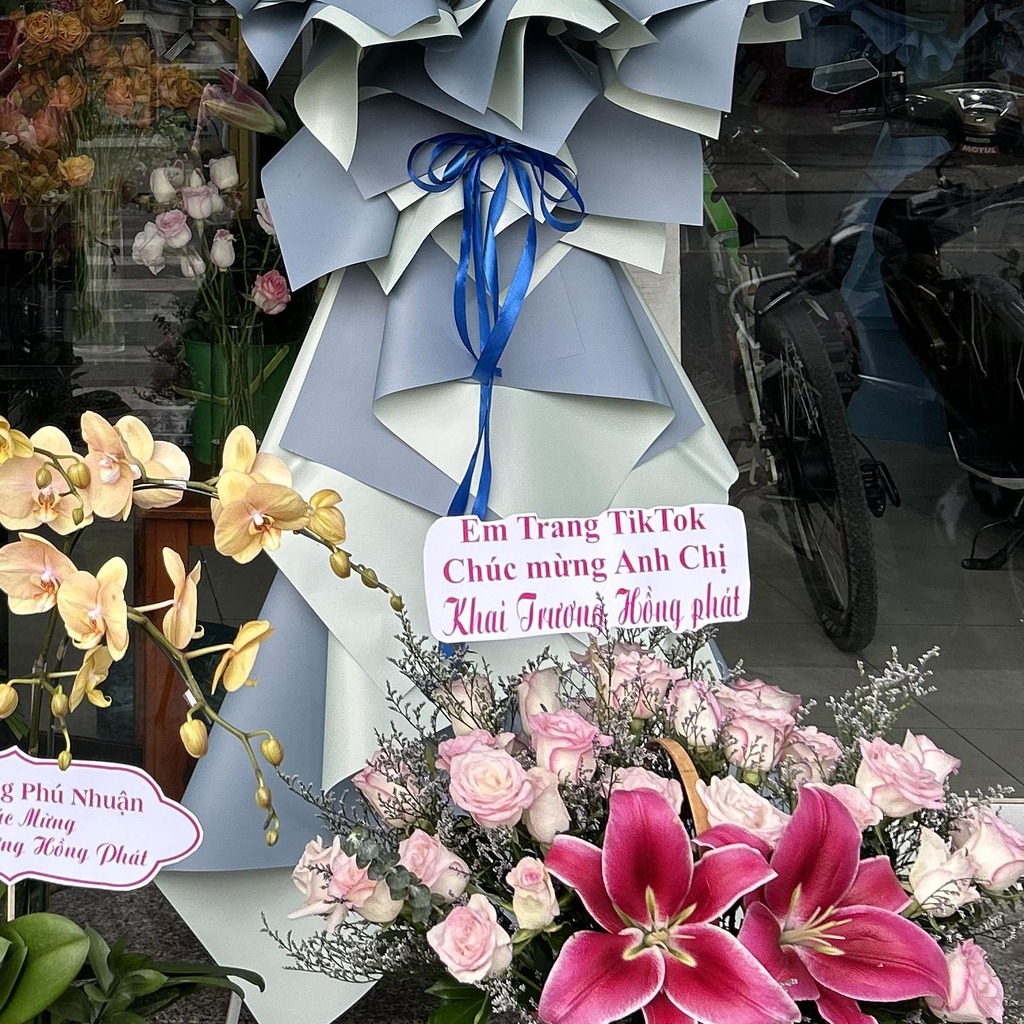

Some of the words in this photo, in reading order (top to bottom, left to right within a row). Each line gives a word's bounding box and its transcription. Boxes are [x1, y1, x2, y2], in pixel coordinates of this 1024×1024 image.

[961, 144, 997, 154] MOTUL
[459, 517, 508, 544] Em
[516, 514, 601, 544] Trang
[606, 506, 707, 536] TikTok
[442, 556, 518, 585] Chúc
[527, 552, 608, 583] mừng
[614, 547, 671, 575] Anh
[679, 543, 728, 575] Chị
[442, 595, 509, 637] Khai
[516, 592, 607, 636] Trương
[615, 585, 685, 630] Hồng
[690, 581, 743, 630] phát
[21, 782, 64, 805] Phú
[70, 788, 145, 817] Nhuận
[17, 807, 78, 836] Mừng
[33, 833, 90, 864] Hồng
[95, 842, 149, 868] Phát
